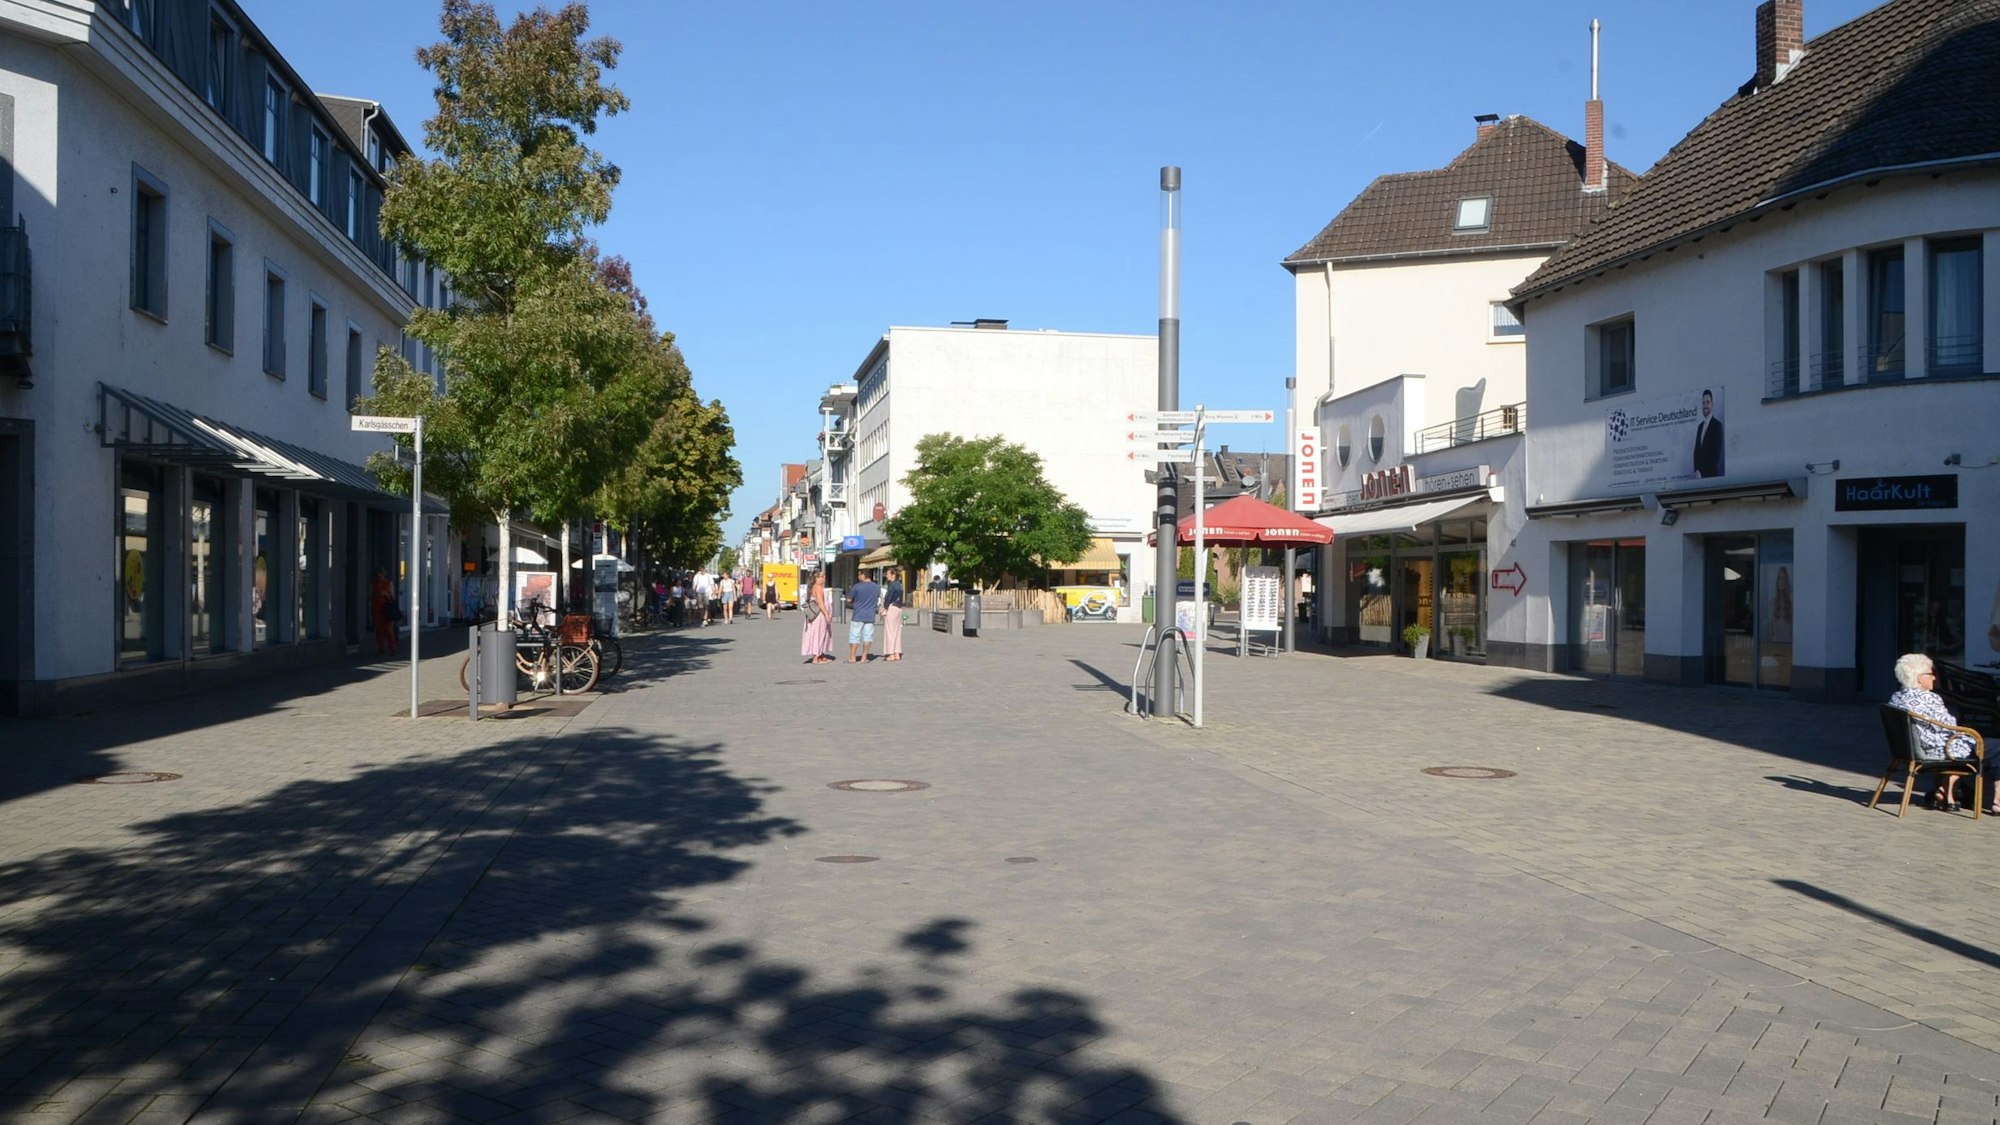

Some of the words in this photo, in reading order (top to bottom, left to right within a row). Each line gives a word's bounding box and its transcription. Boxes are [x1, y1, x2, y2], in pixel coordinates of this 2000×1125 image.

[358, 419, 408, 430] Karlsgässchen
[1630, 417, 1636, 428] IT
[1636, 415, 1658, 426] Service
[1658, 407, 1697, 421] Deutschland
[1845, 483, 1933, 501] HaarKult
